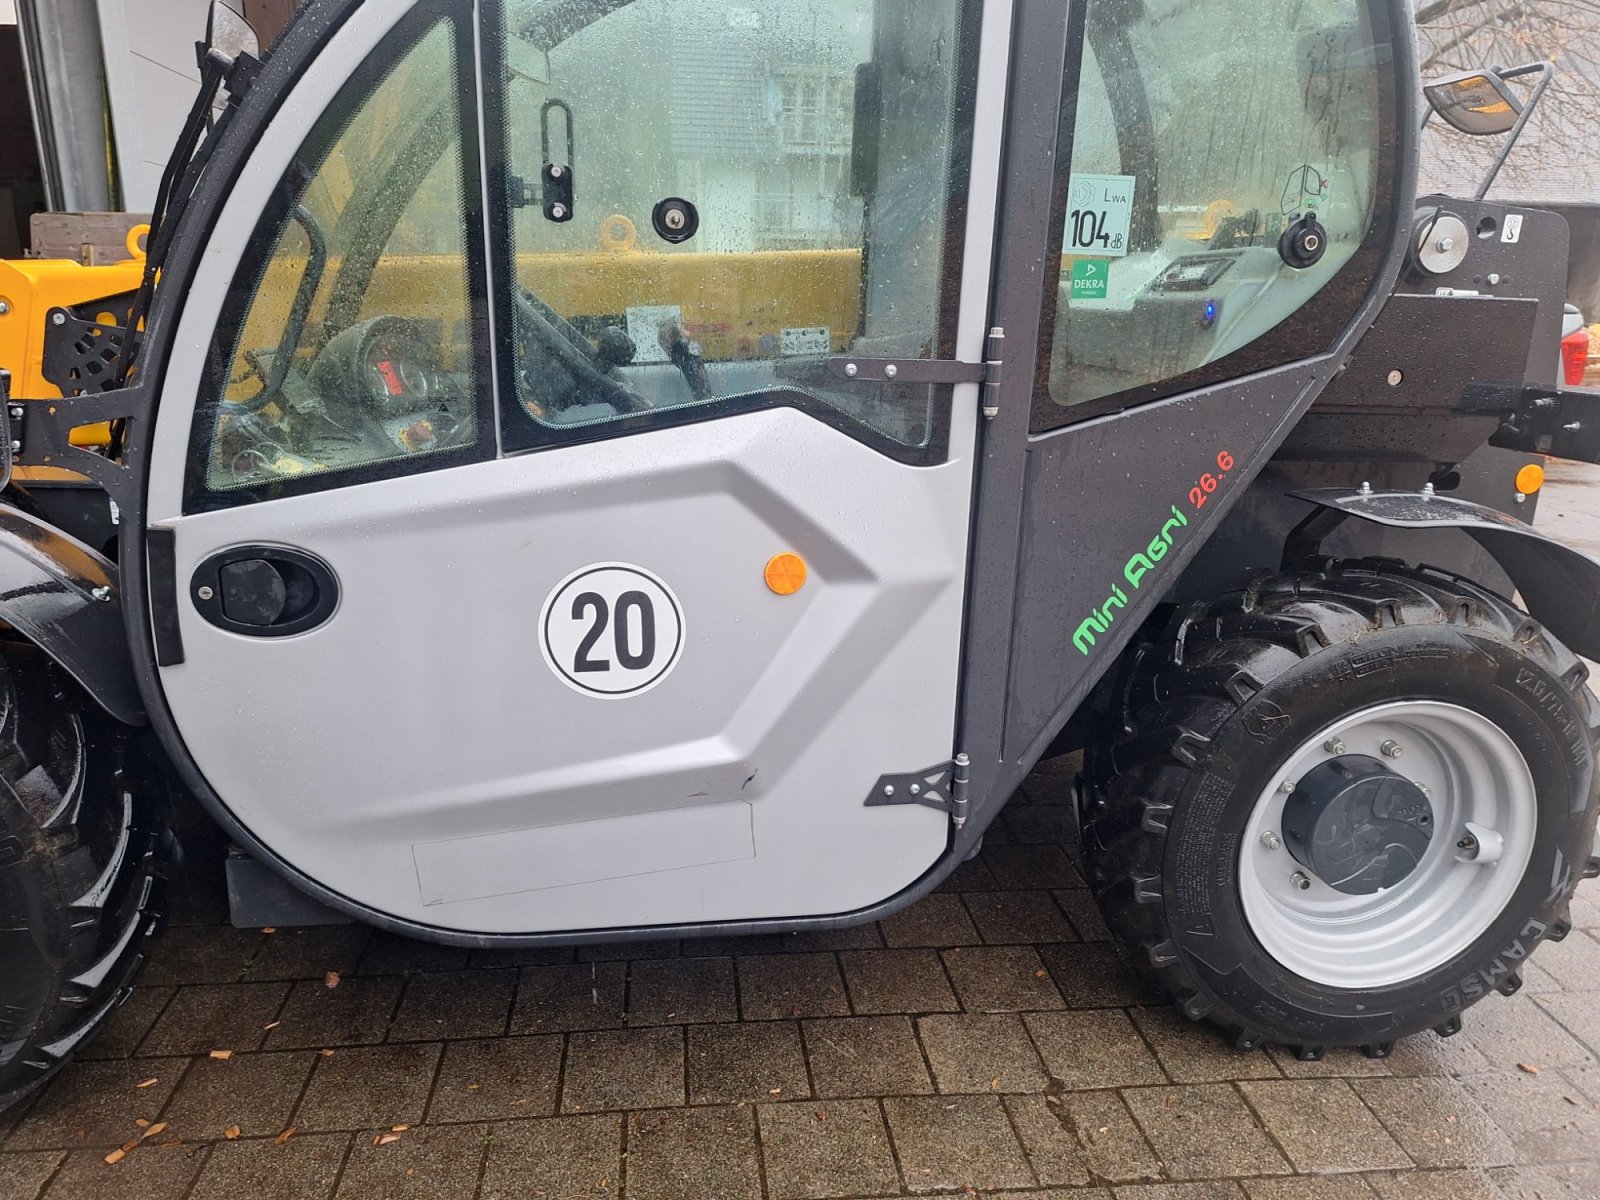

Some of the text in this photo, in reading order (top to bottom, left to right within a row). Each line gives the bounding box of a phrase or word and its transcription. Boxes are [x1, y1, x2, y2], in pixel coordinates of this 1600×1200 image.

[1071, 209, 1123, 249] 104 dB
[1074, 279, 1105, 289] DEKRA
[1189, 450, 1234, 509] 26.6
[571, 590, 656, 673] 20
